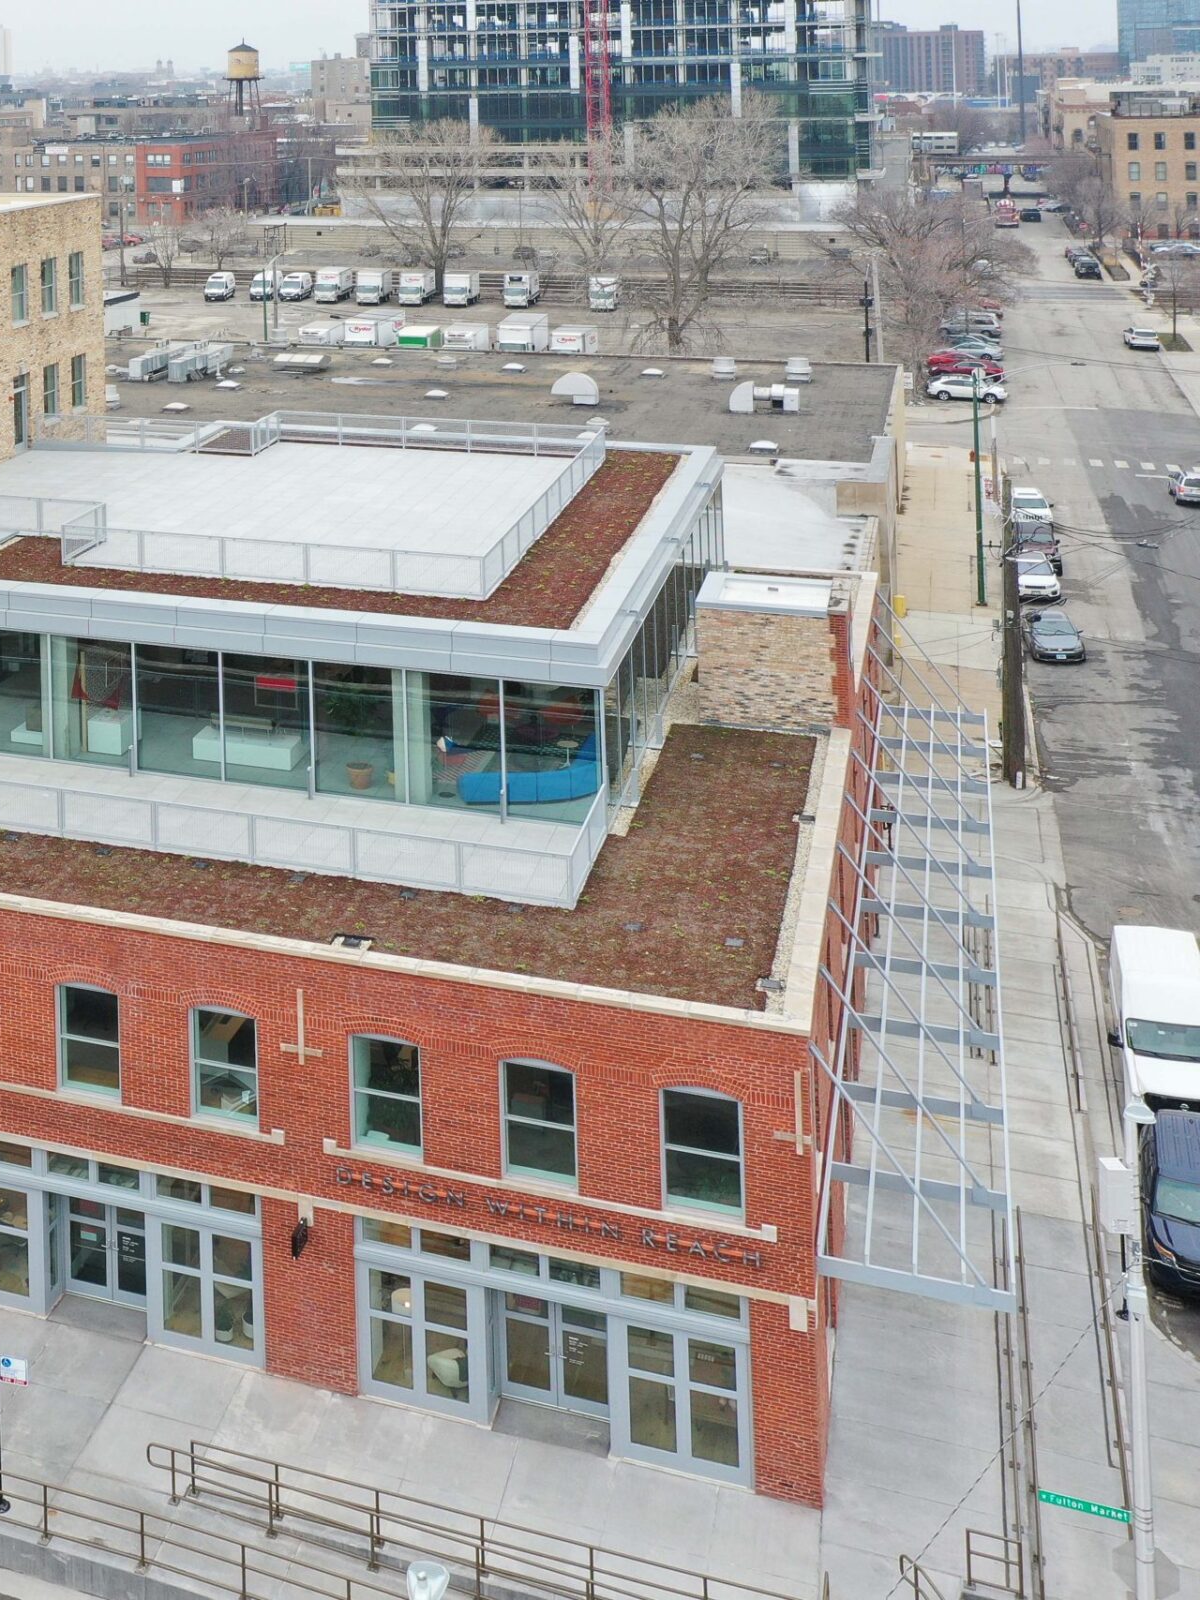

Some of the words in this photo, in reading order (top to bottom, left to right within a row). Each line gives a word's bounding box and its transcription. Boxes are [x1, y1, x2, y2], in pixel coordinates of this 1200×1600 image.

[336, 1166, 466, 1207] DESIGN
[485, 1196, 621, 1239] WITHIN
[642, 1228, 763, 1268] REACH
[1049, 1494, 1084, 1510] Fulton
[1090, 1504, 1129, 1521] Market
